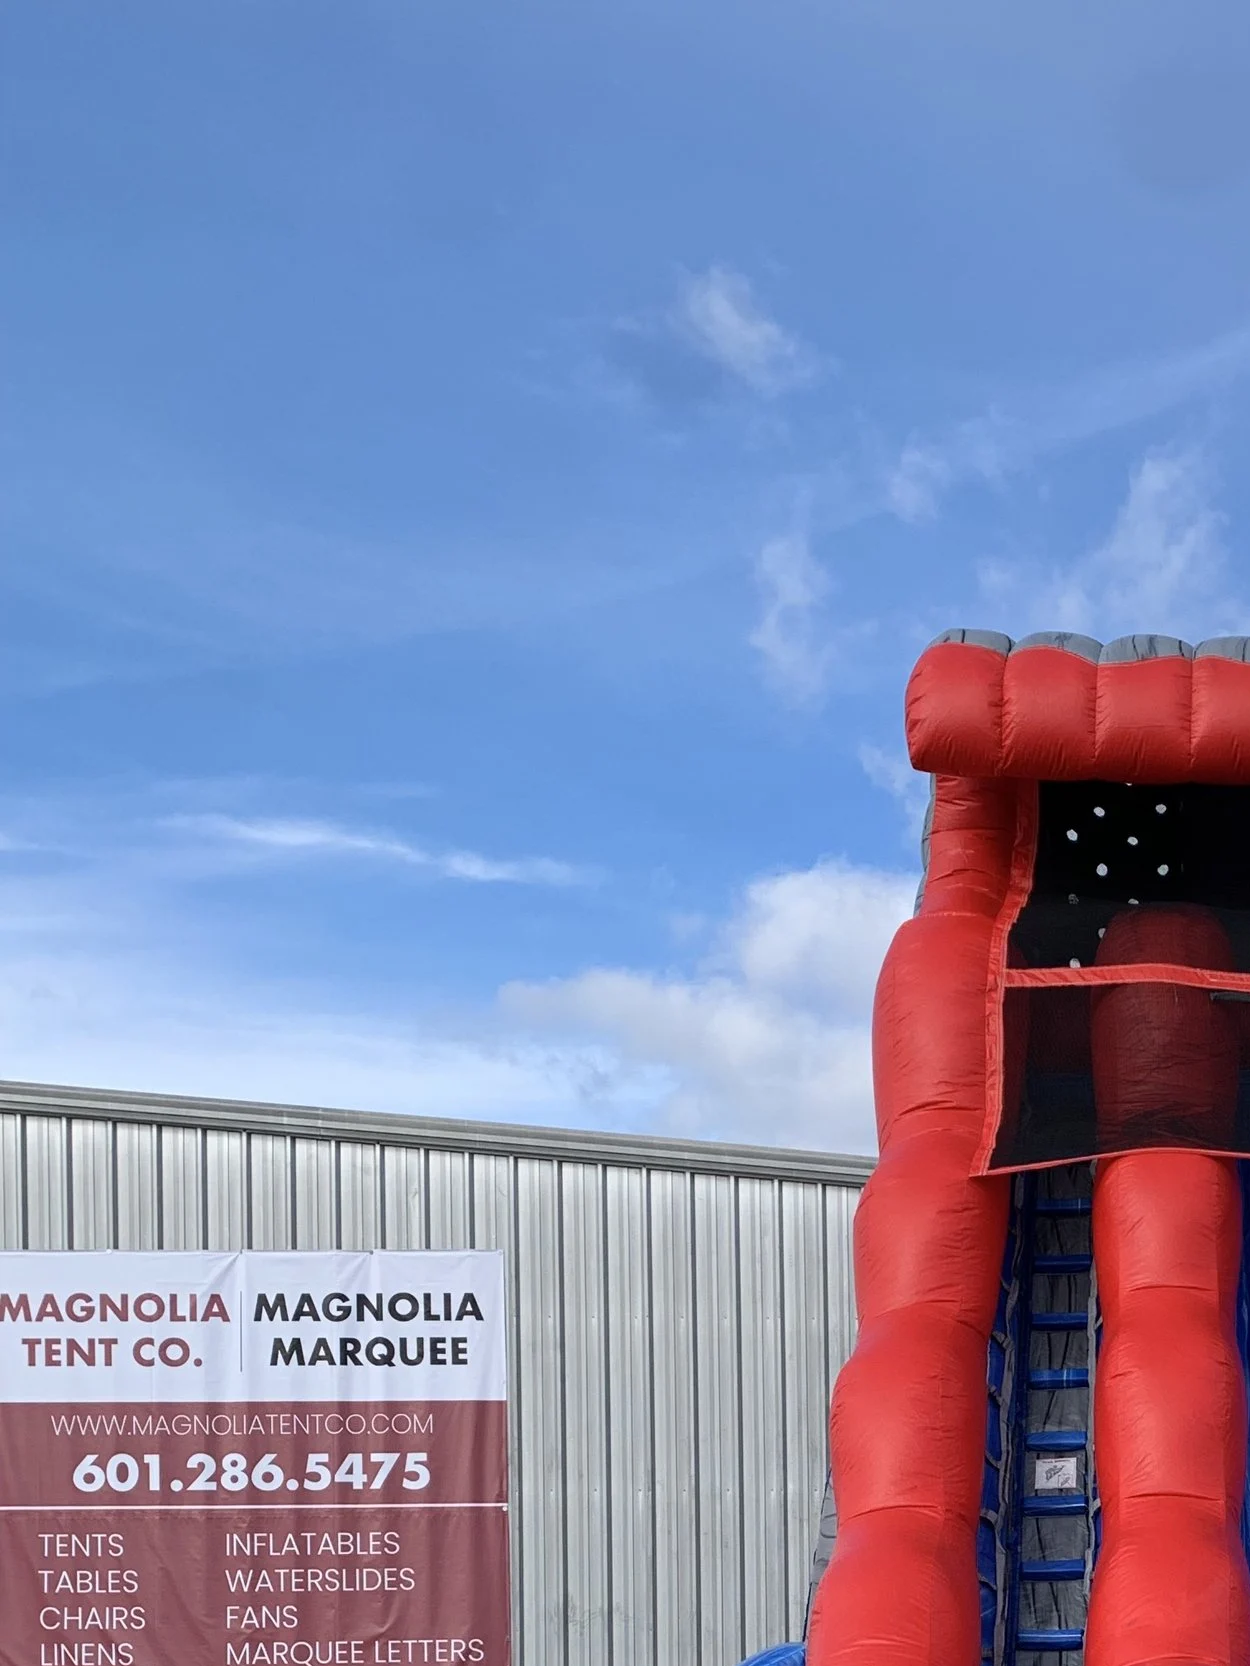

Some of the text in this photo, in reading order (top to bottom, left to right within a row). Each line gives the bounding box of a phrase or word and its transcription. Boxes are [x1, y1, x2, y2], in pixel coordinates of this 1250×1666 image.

[0, 1292, 231, 1323] MAGNOLIA
[253, 1291, 485, 1323] MAGNOLIA
[21, 1336, 203, 1368] TENT CO.
[269, 1336, 469, 1368] MARQUEE
[50, 1413, 435, 1437] WWW.MAGNOLIATENTCO.COM
[72, 1452, 431, 1492] 601.286.5475
[38, 1533, 125, 1558] TENTS
[225, 1531, 401, 1556] INFLATABLES
[38, 1569, 139, 1594] TABLES
[225, 1567, 416, 1592] WATERSLIDES
[39, 1606, 147, 1631] CHAIRS
[226, 1604, 299, 1629] FANS
[40, 1642, 135, 1666] LINENS
[373, 1638, 485, 1664] LETTERS
